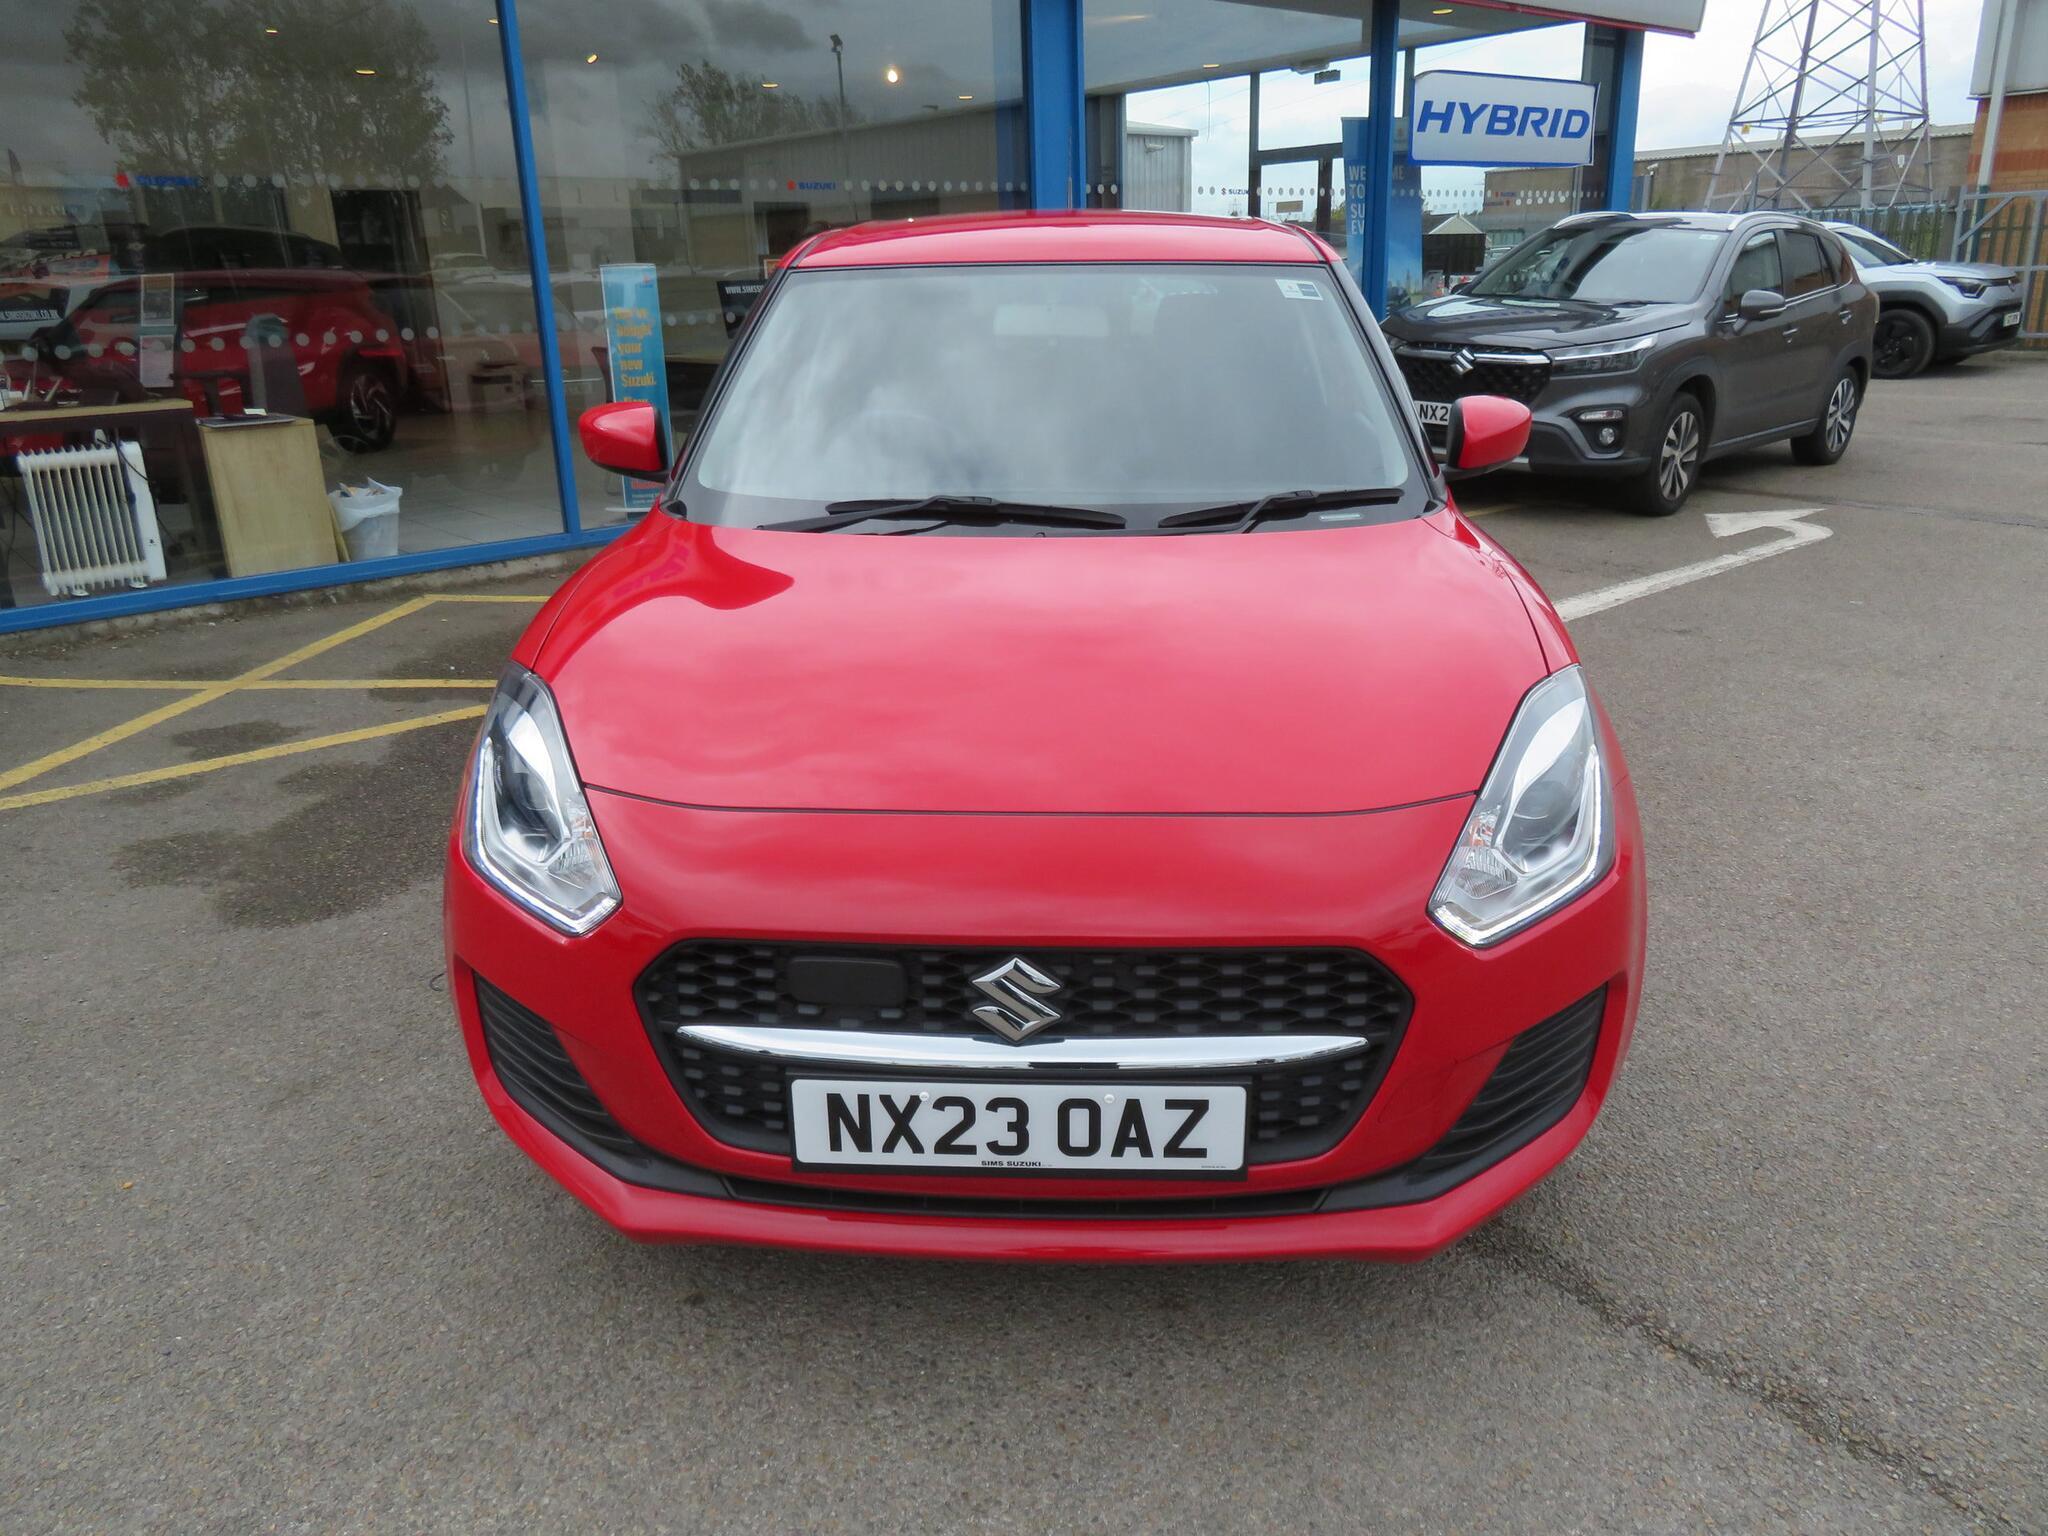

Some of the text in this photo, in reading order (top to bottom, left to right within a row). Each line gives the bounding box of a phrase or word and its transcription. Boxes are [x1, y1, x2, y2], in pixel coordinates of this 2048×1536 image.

[1416, 100, 1591, 139] HYBRID
[825, 1092, 1210, 1159] NX23 OAZ
[1006, 1160, 1042, 1168] SUZUKI
